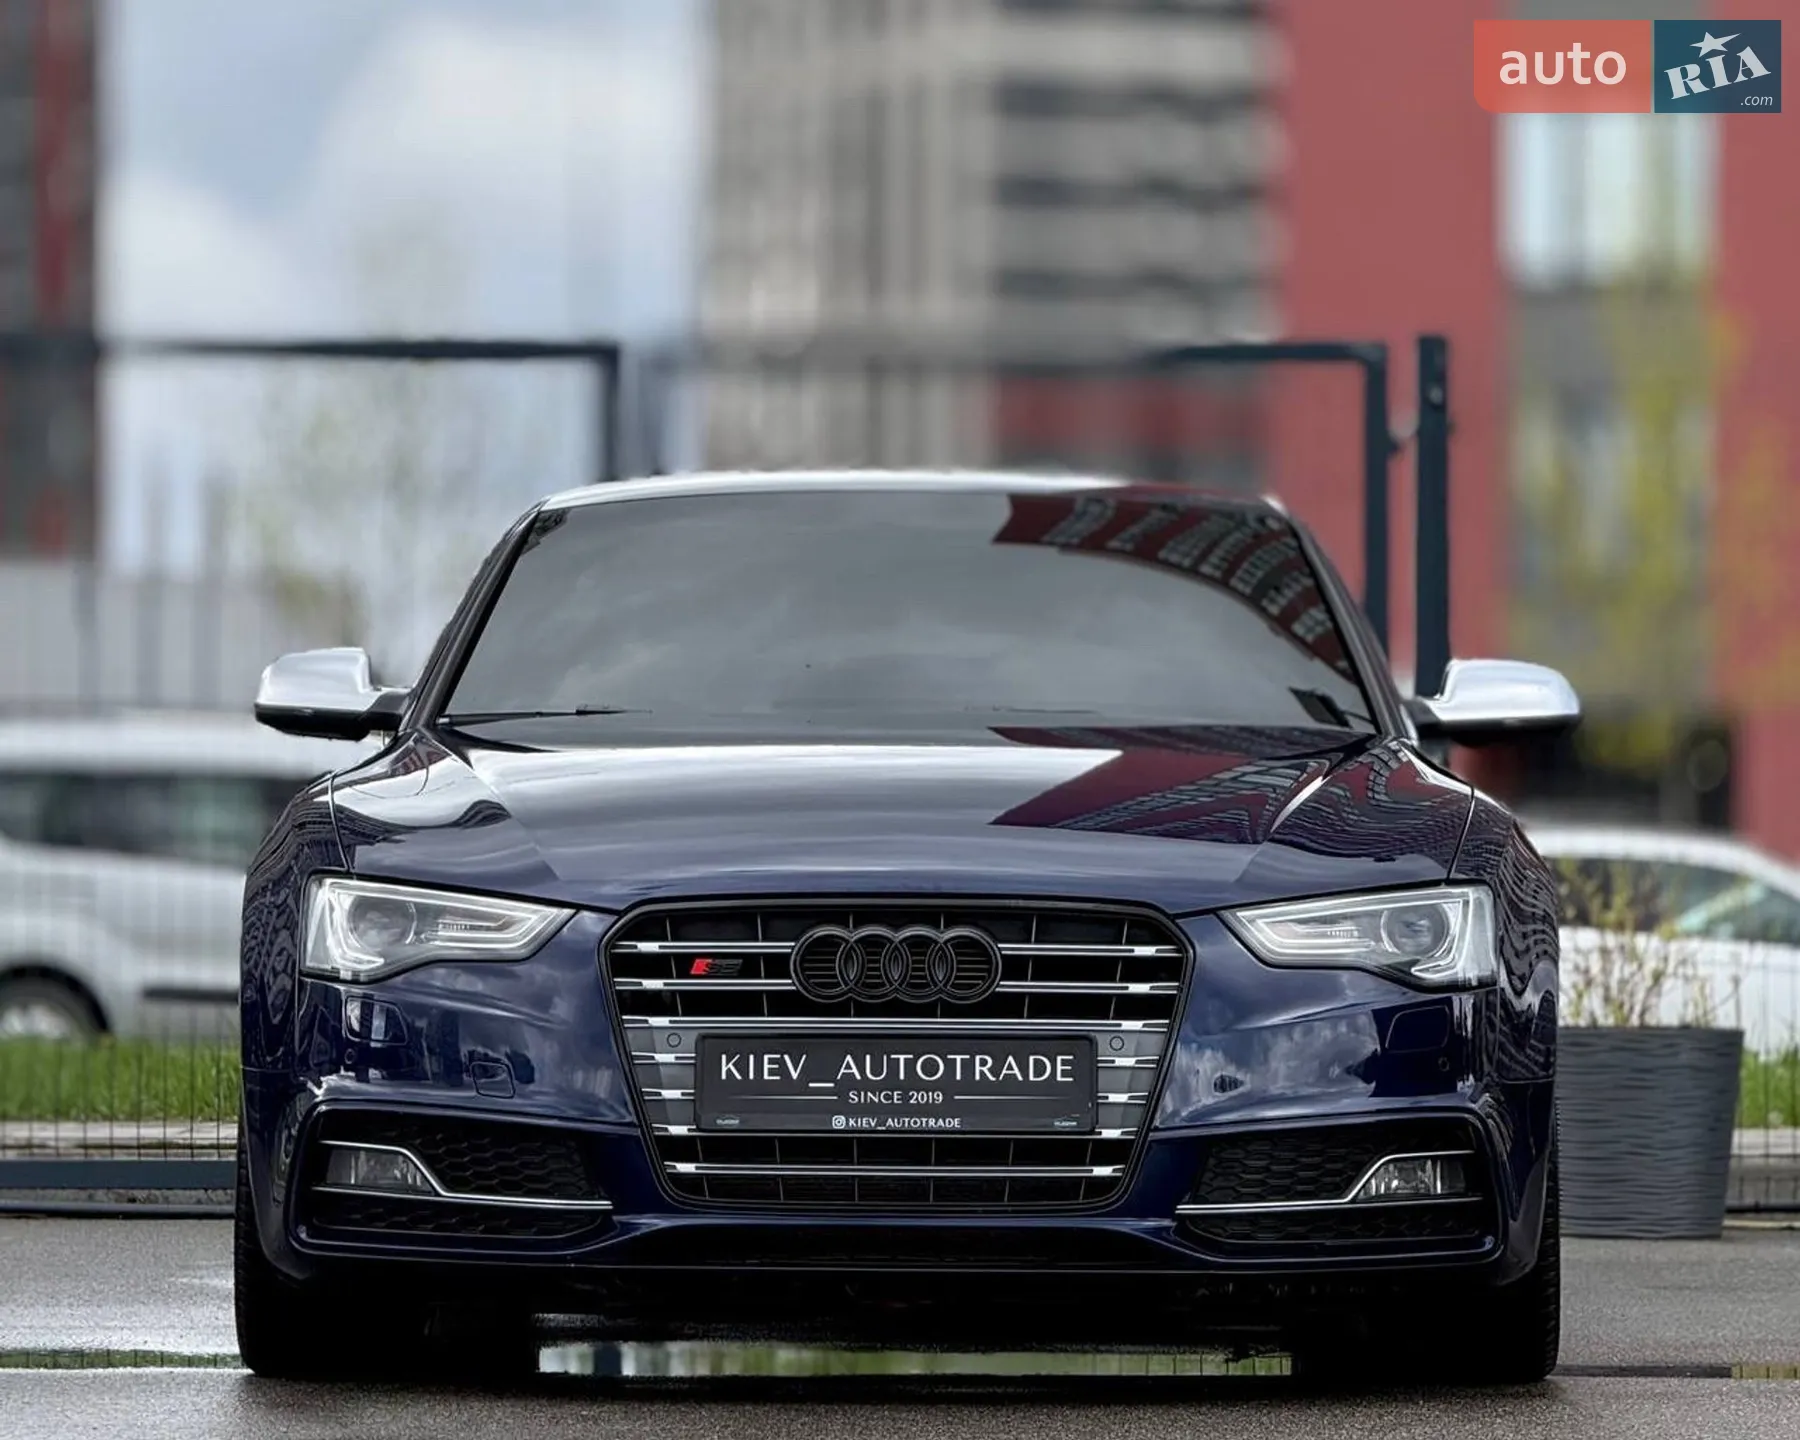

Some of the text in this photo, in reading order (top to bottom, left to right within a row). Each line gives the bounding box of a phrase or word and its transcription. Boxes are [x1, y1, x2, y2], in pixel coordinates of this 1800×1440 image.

[720, 1053, 1075, 1088] KIEV_AUTOTRADE
[848, 1090, 944, 1104] SINCE 2019
[848, 1116, 961, 1130] KIEV_AUTOTRADE
